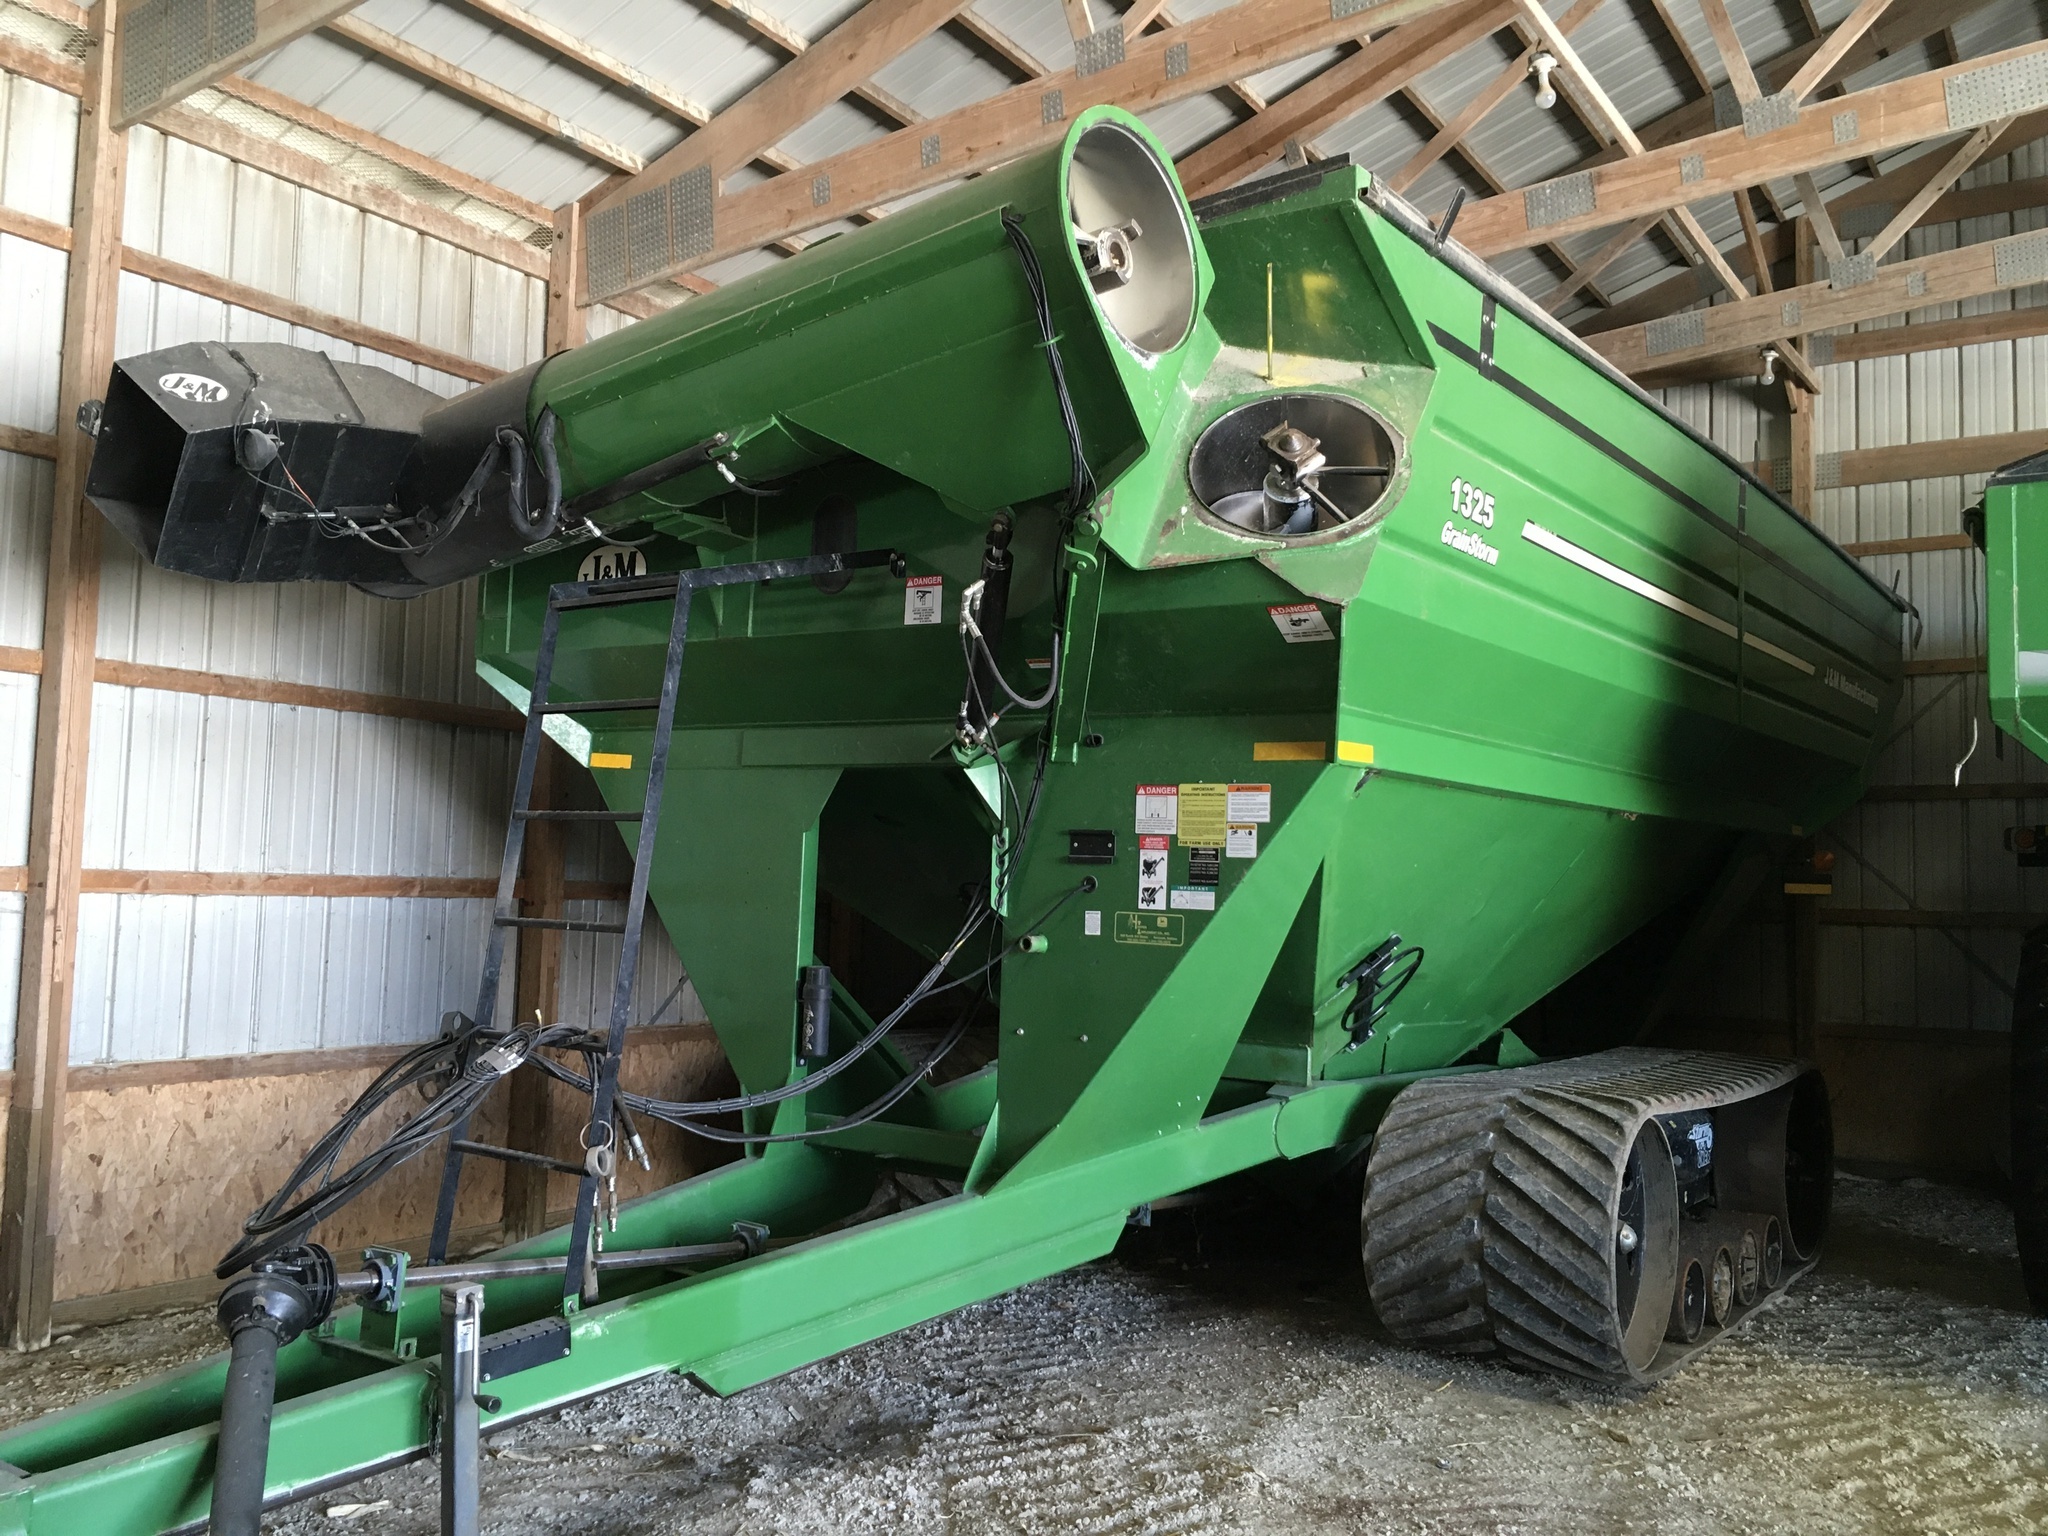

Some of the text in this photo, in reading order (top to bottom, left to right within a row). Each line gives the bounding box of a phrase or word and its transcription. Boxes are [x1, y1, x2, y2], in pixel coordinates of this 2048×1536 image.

[162, 376, 222, 401] J&M
[1450, 476, 1495, 530] 1325
[1441, 519, 1499, 566] GrainStorm
[582, 551, 638, 581] J&M
[914, 576, 943, 585] DANGER
[1279, 604, 1318, 614] DANGER
[1146, 786, 1177, 794] DANGER
